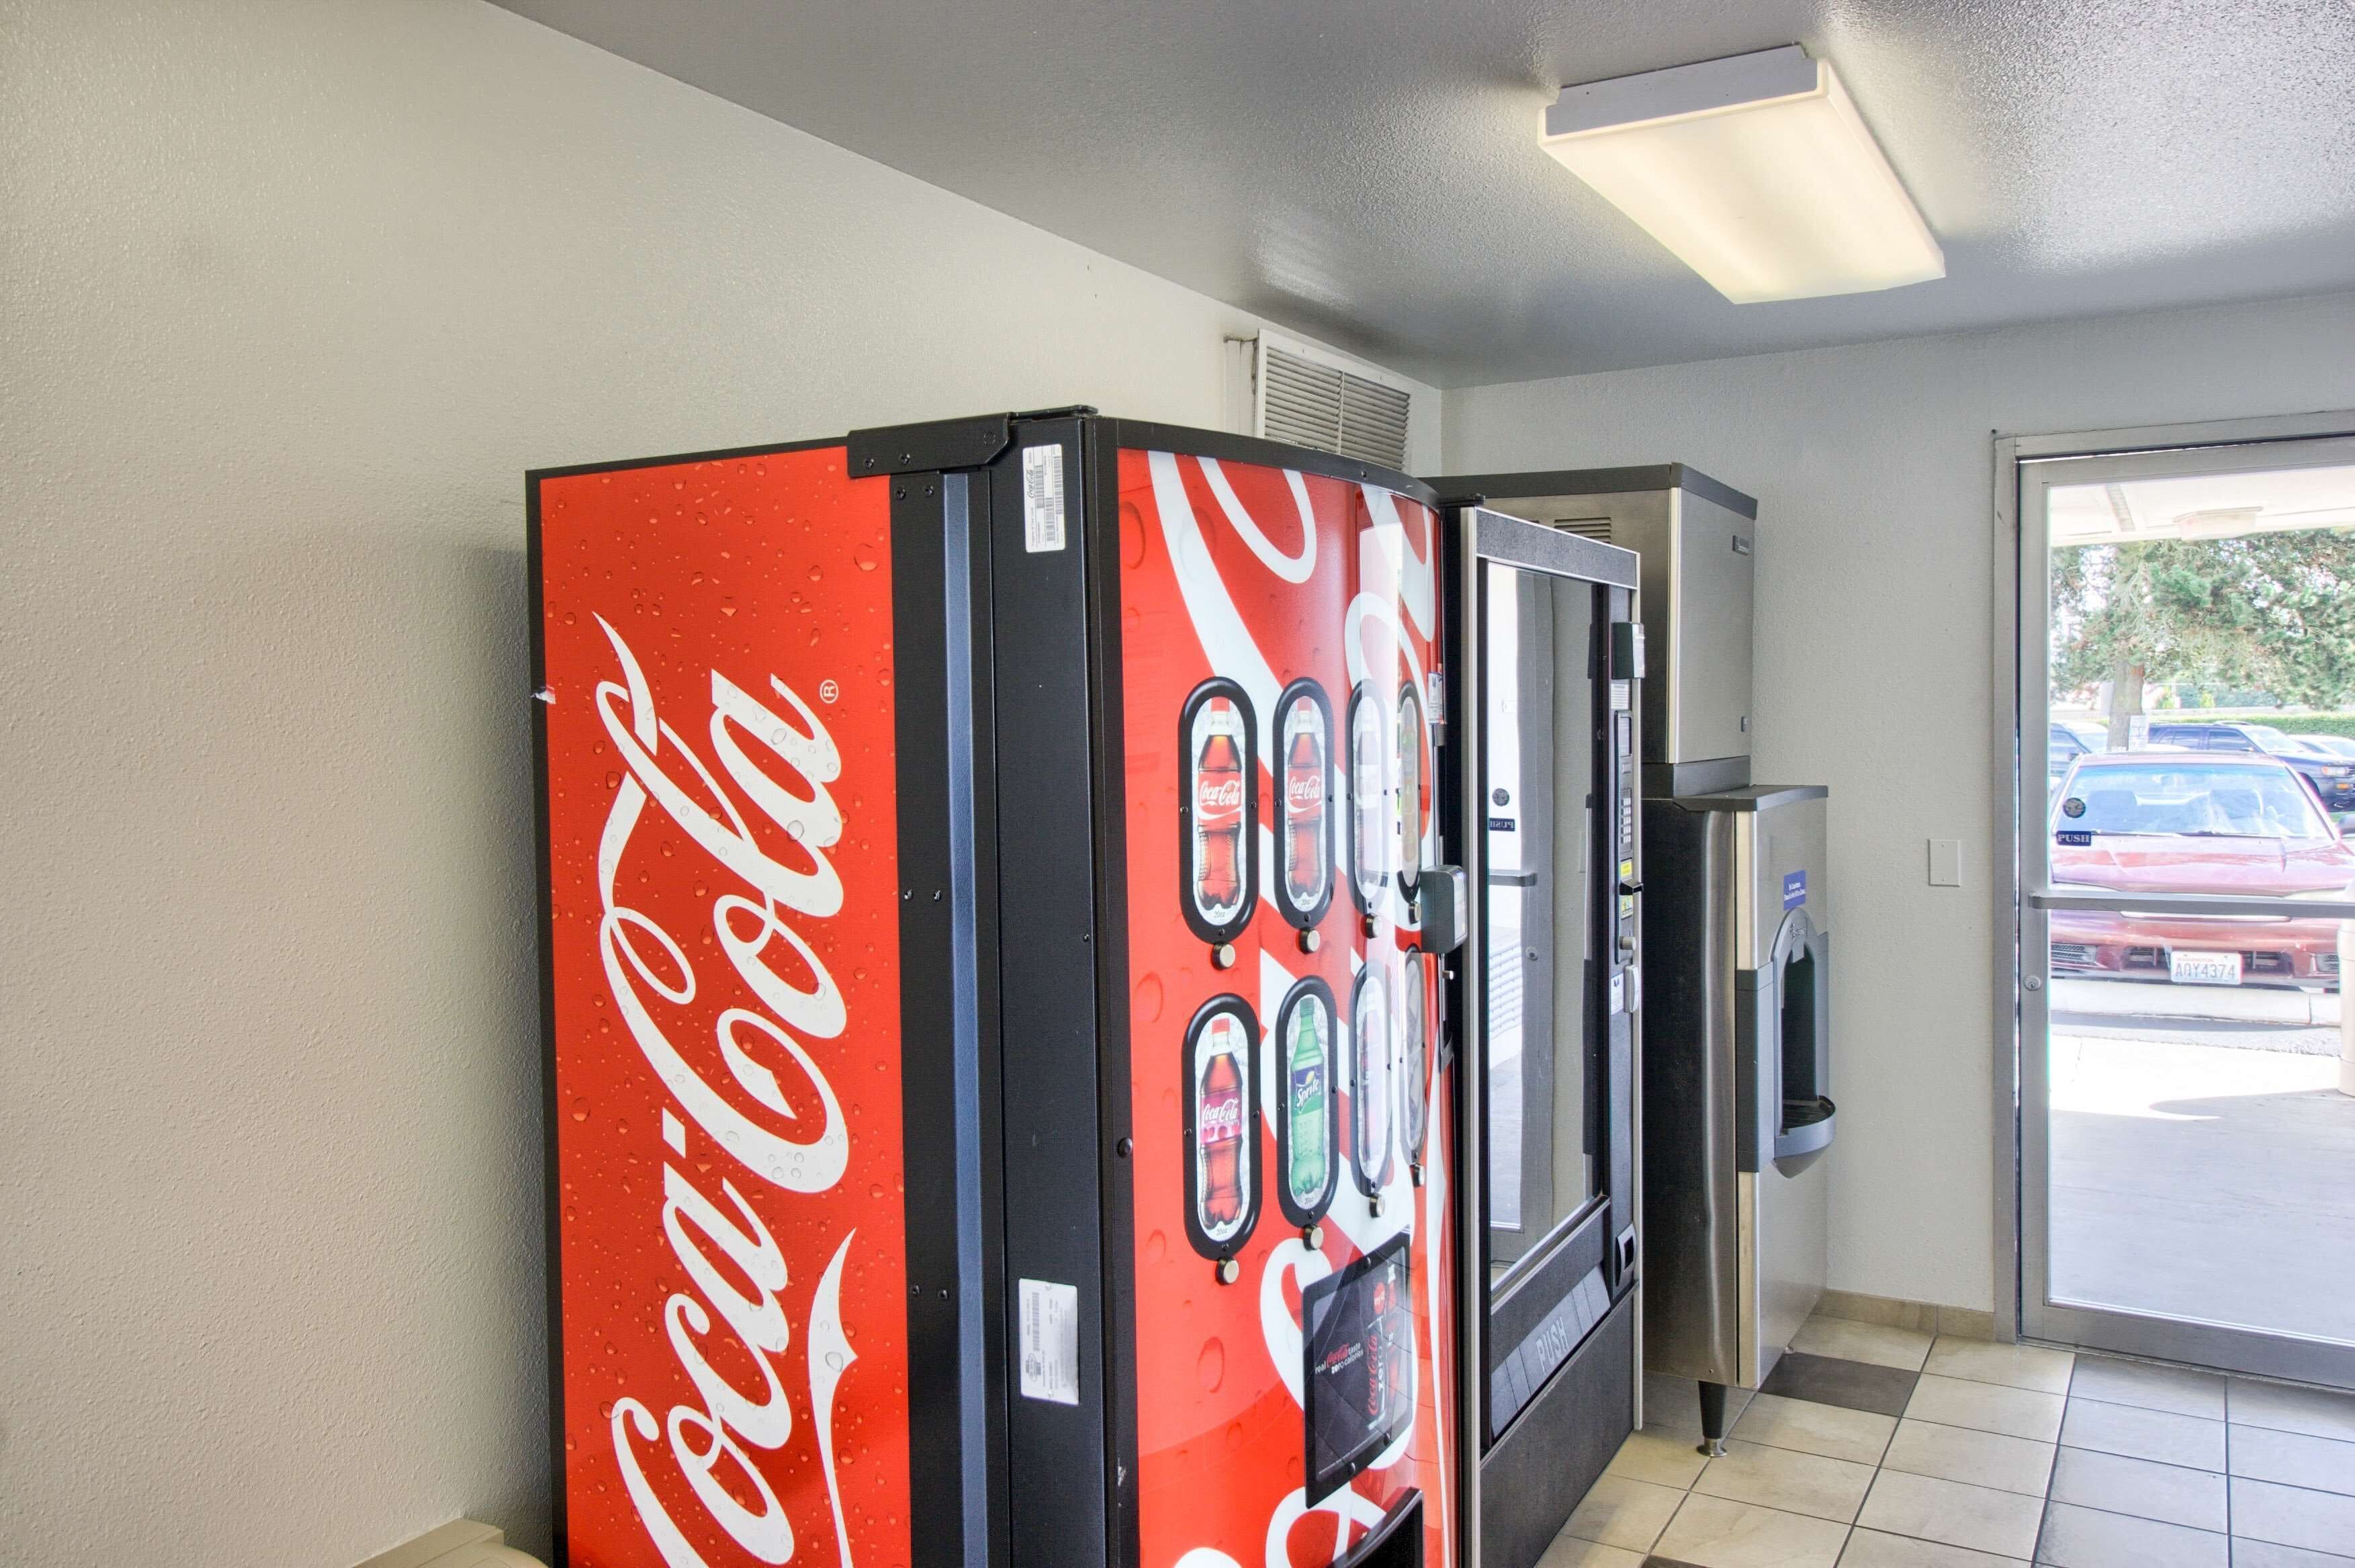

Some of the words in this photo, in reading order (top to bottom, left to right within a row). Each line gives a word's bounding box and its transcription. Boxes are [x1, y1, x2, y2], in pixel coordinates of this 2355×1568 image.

[1199, 779, 1241, 806] Coca-Cola
[1289, 775, 1321, 800] Coca-Cola
[2057, 834, 2090, 843] PUSH
[592, 611, 858, 1568] Coca-Cola
[1297, 1078, 1320, 1107] Sprite
[1202, 1097, 1239, 1127] Coca-Cola
[1315, 1361, 1326, 1375] real
[1349, 1342, 1361, 1355] taste
[1536, 1316, 1569, 1377] PUSH
[1331, 1361, 1344, 1375] zero
[1344, 1348, 1364, 1366] calories
